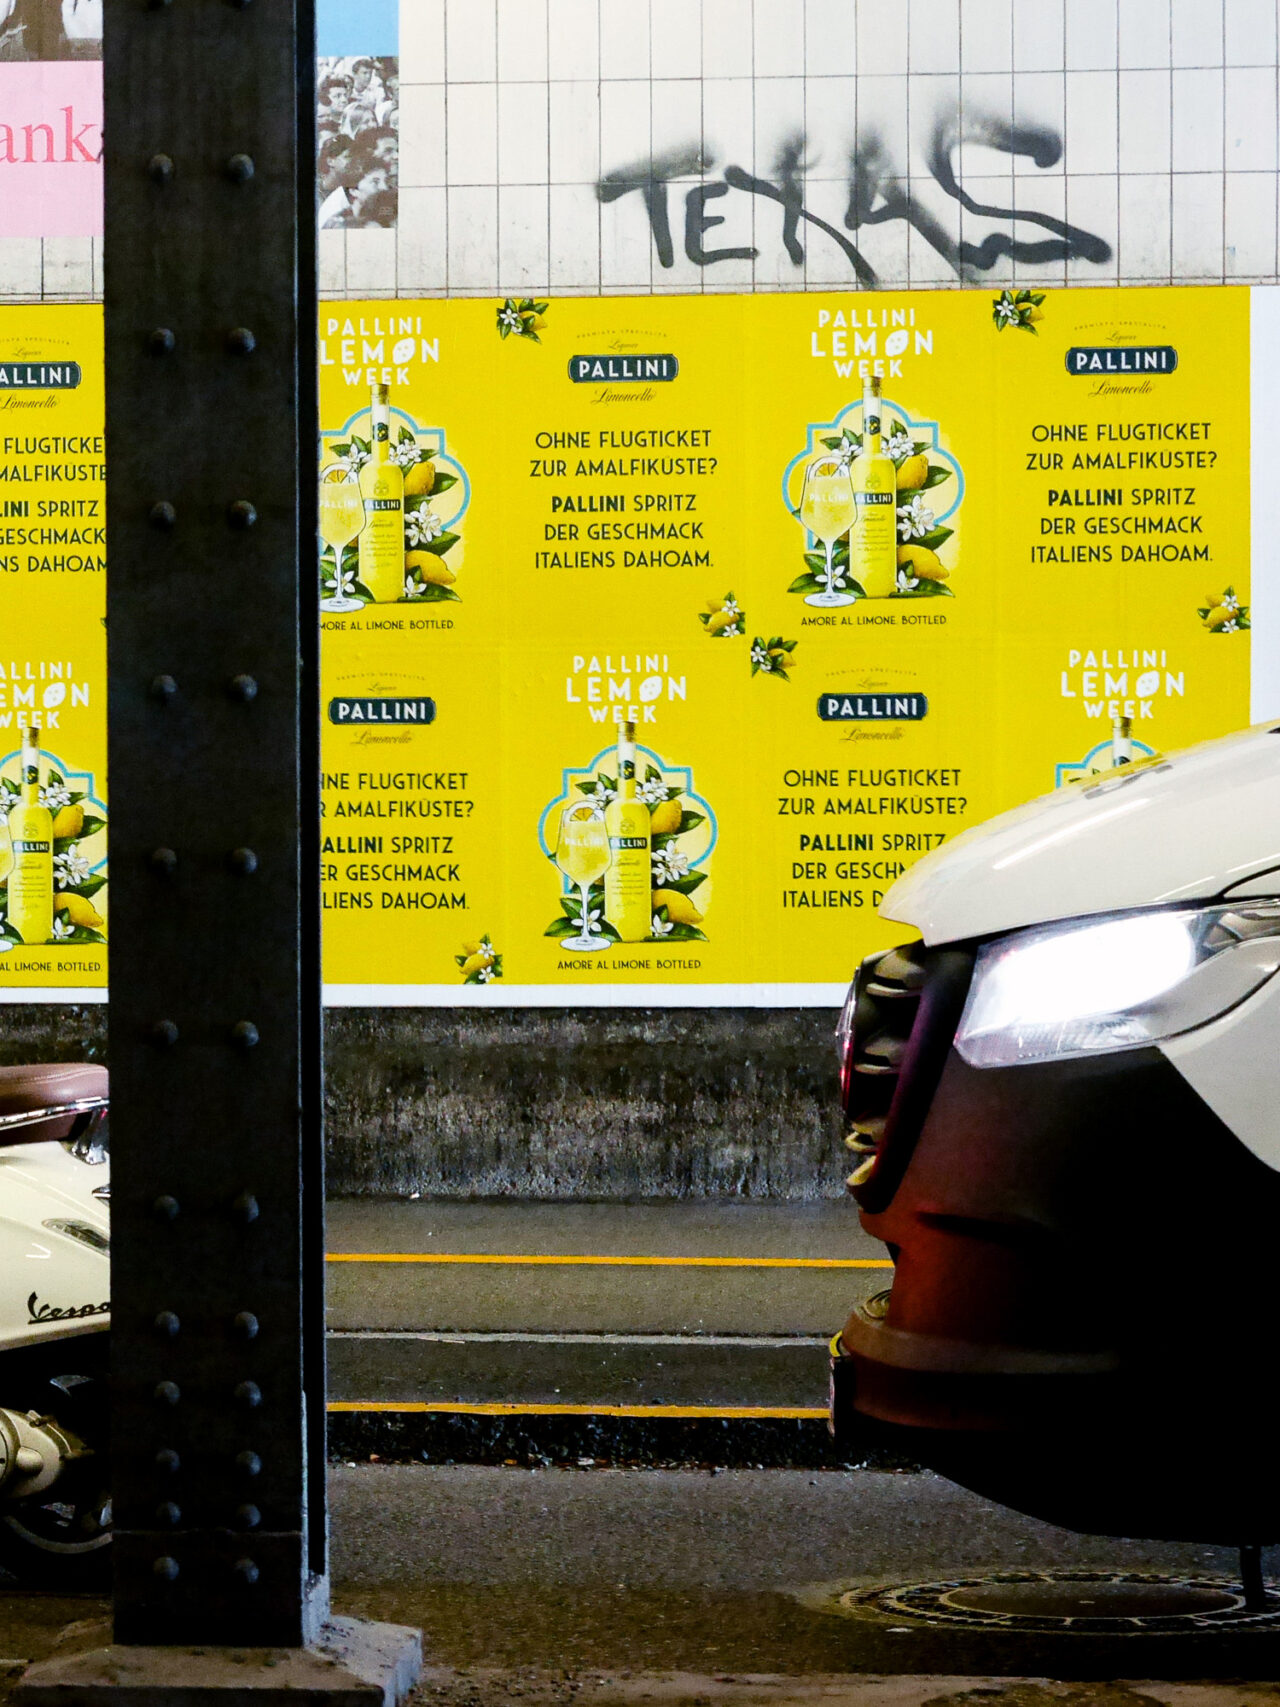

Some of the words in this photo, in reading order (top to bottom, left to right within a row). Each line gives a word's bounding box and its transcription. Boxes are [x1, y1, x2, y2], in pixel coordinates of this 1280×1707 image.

[328, 317, 421, 336] PALLINI
[818, 309, 915, 328] PALLINI
[319, 338, 439, 364] LEMON
[811, 330, 933, 357] LEMON
[580, 360, 667, 377] PALLINI
[833, 360, 903, 378] WEEK
[1077, 352, 1166, 369] PALLINI
[343, 367, 409, 386] WEEK
[535, 432, 590, 449] OHNE
[600, 430, 711, 448] FLUGTICKET
[1032, 424, 1088, 442] OHNE
[1097, 423, 1211, 441] FLUGTICKET
[5, 437, 105, 455] FLUGTICKE
[530, 460, 566, 477] ZUR
[575, 458, 717, 476] AMALFIKÜSTE?
[1026, 453, 1063, 470] ZUR
[1072, 451, 1217, 470] AMALFIKÜSTE?
[552, 495, 624, 513] PALLINI
[633, 494, 696, 512] SPRITZ
[1048, 489, 1122, 506] PALLINI
[1131, 488, 1195, 505] SPRITZ
[37, 500, 98, 517] SPRITZ
[545, 524, 579, 541] DER
[587, 522, 703, 540] GESCHMACK
[1041, 518, 1075, 535] DER
[1084, 516, 1203, 534] GESCHMACK
[536, 551, 615, 569] ITALIENS
[624, 550, 713, 568] DAHOAM.
[1032, 545, 1112, 563] ITALIENS
[1122, 544, 1213, 562] DAHOAM.
[28, 555, 107, 572] DAHOAM
[319, 621, 346, 631] MORE
[350, 622, 362, 630] AL
[801, 616, 836, 626] AMORE
[841, 617, 852, 625] AL
[573, 654, 668, 672] PALLINI
[1069, 650, 1166, 668] PALLINI
[567, 676, 685, 702] LEMON
[1061, 671, 1184, 697] LEMON
[339, 703, 425, 719] PALLINI
[589, 705, 656, 723] WEEK
[828, 699, 916, 715] PALLINI
[1083, 700, 1153, 719] WEEK
[358, 773, 468, 790] FLUGTICKET
[784, 770, 839, 787] OHNE
[848, 769, 961, 786] FLUGTICKET
[334, 799, 474, 817] AMALFIKÜSTE?
[778, 798, 815, 815] ZUR
[824, 795, 967, 815] AMALFIKÜSTE?
[322, 837, 382, 854] ALLINI
[391, 836, 453, 853] SPRITZ
[800, 834, 873, 851] PALLINI
[882, 834, 945, 851] SPRITZ
[320, 865, 338, 881] ER
[346, 864, 460, 881] GESCHMACK
[792, 862, 827, 879] DER
[836, 862, 906, 879] GESCH
[322, 893, 373, 909] LIENS
[382, 892, 469, 909] DAHOAM.
[783, 890, 864, 908] ITALIENS
[0, 962, 10, 971] AL
[558, 960, 592, 969] AMORE
[597, 961, 608, 969] AL
